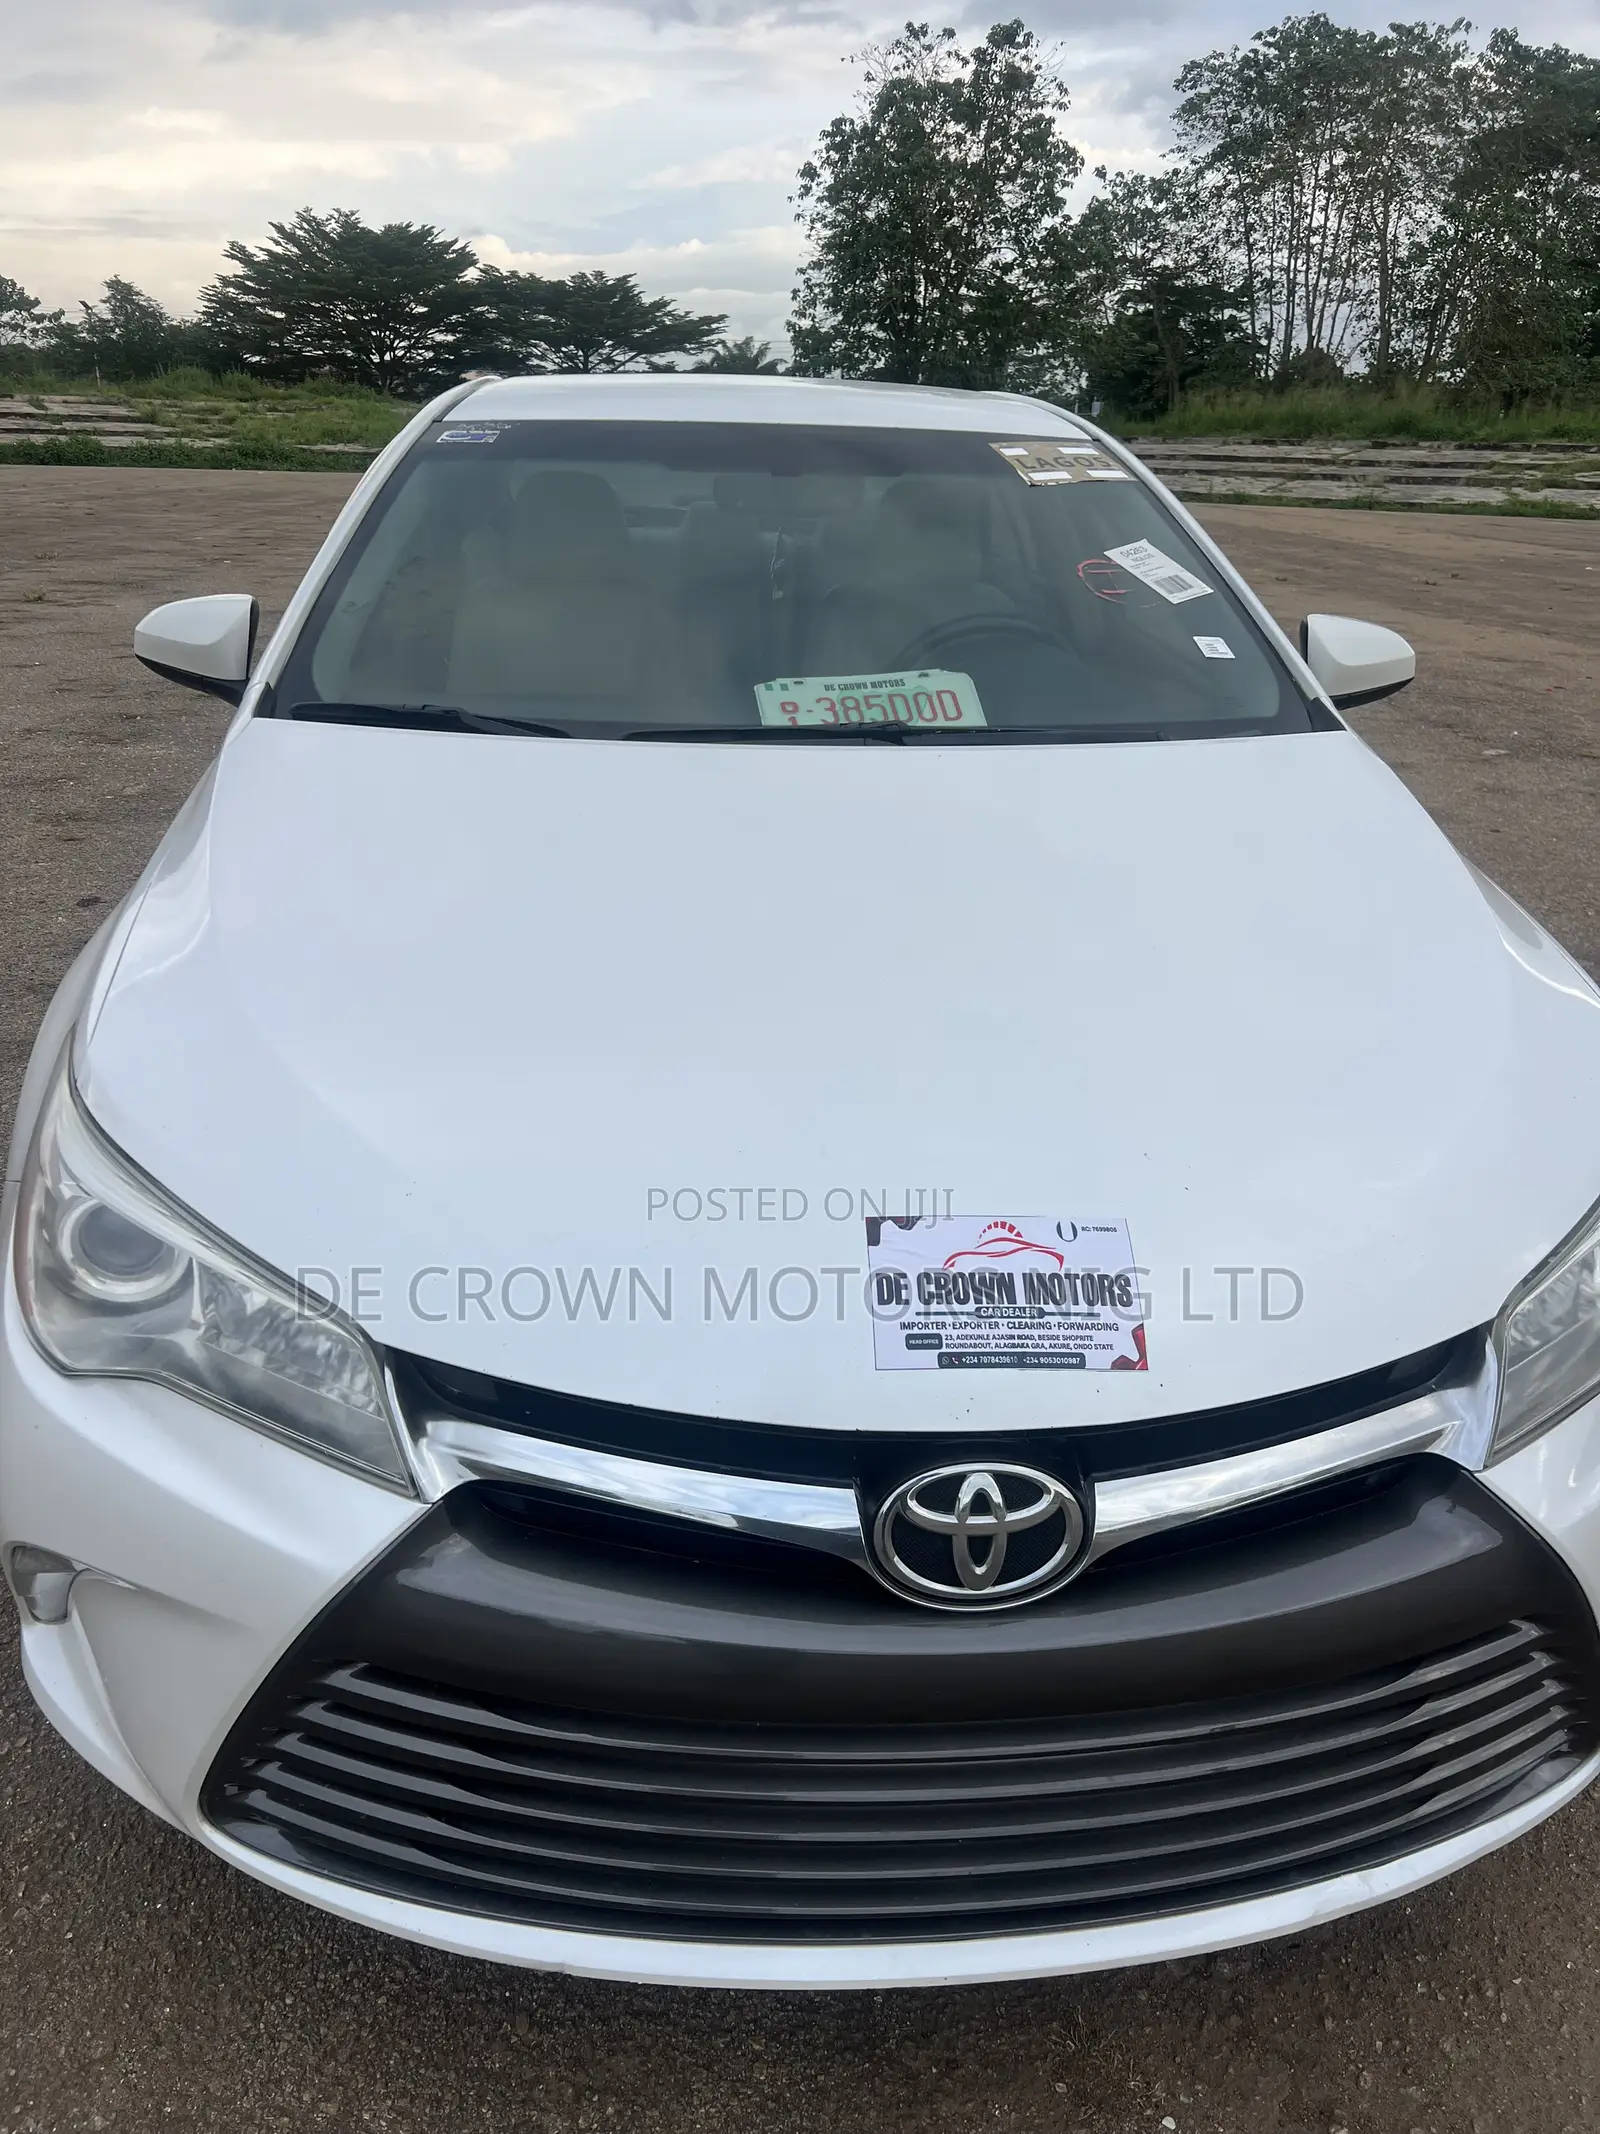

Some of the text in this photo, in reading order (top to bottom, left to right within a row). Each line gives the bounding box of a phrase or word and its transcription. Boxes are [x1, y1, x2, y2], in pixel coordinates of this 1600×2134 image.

[1014, 456, 1112, 470] LAGOS
[838, 682, 868, 691] CROWN
[870, 678, 906, 689] MOTORS
[876, 1271, 1134, 1308] DE CROWN MOTORS
[980, 1307, 1038, 1317] CAR DEALER
[900, 1321, 1119, 1332] IMPORTER EXPORTER CLEARING FORWARDING
[956, 1333, 990, 1341] ADEKUNLE
[1038, 1334, 1060, 1342] BESIDE
[945, 1342, 993, 1350] ROUNDABOUT,
[1094, 1343, 1114, 1351] STATE
[961, 1356, 978, 1364] +234
